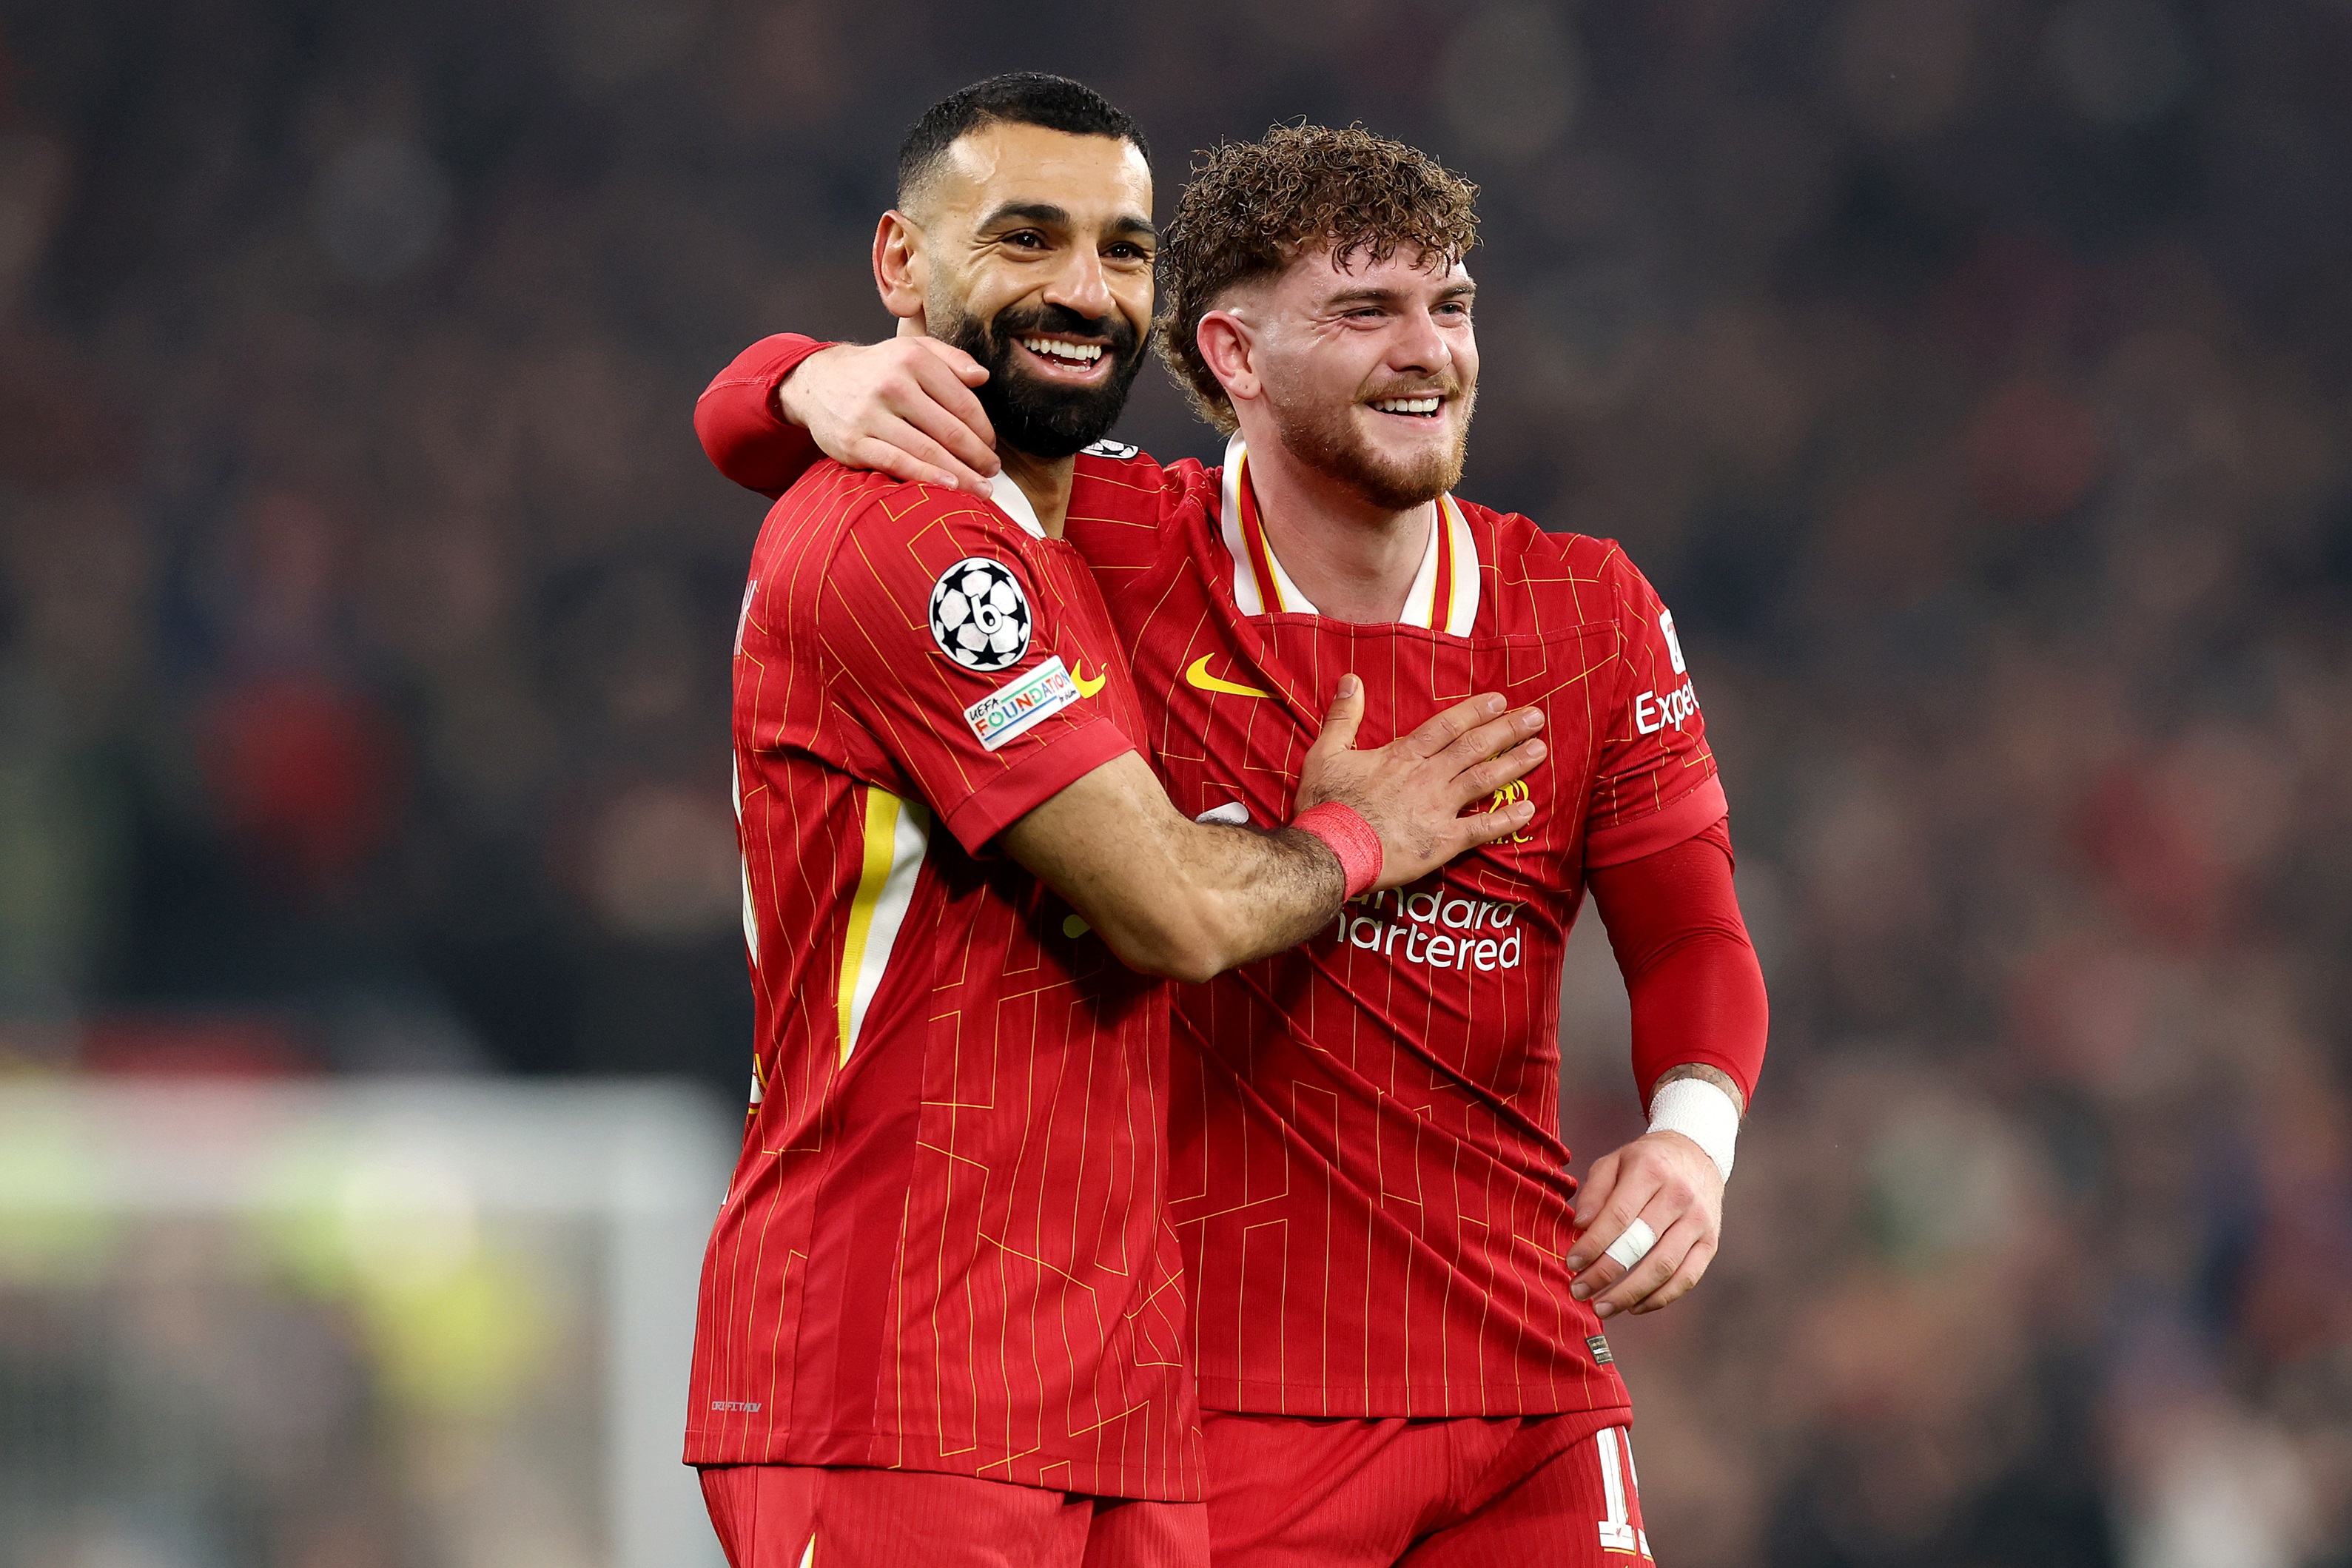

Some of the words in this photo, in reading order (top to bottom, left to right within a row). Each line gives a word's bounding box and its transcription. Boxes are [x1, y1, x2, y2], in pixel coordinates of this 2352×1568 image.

[970, 593, 1004, 634] 6
[970, 698, 999, 721] UEFA
[975, 670, 1070, 737] FOUNDATION
